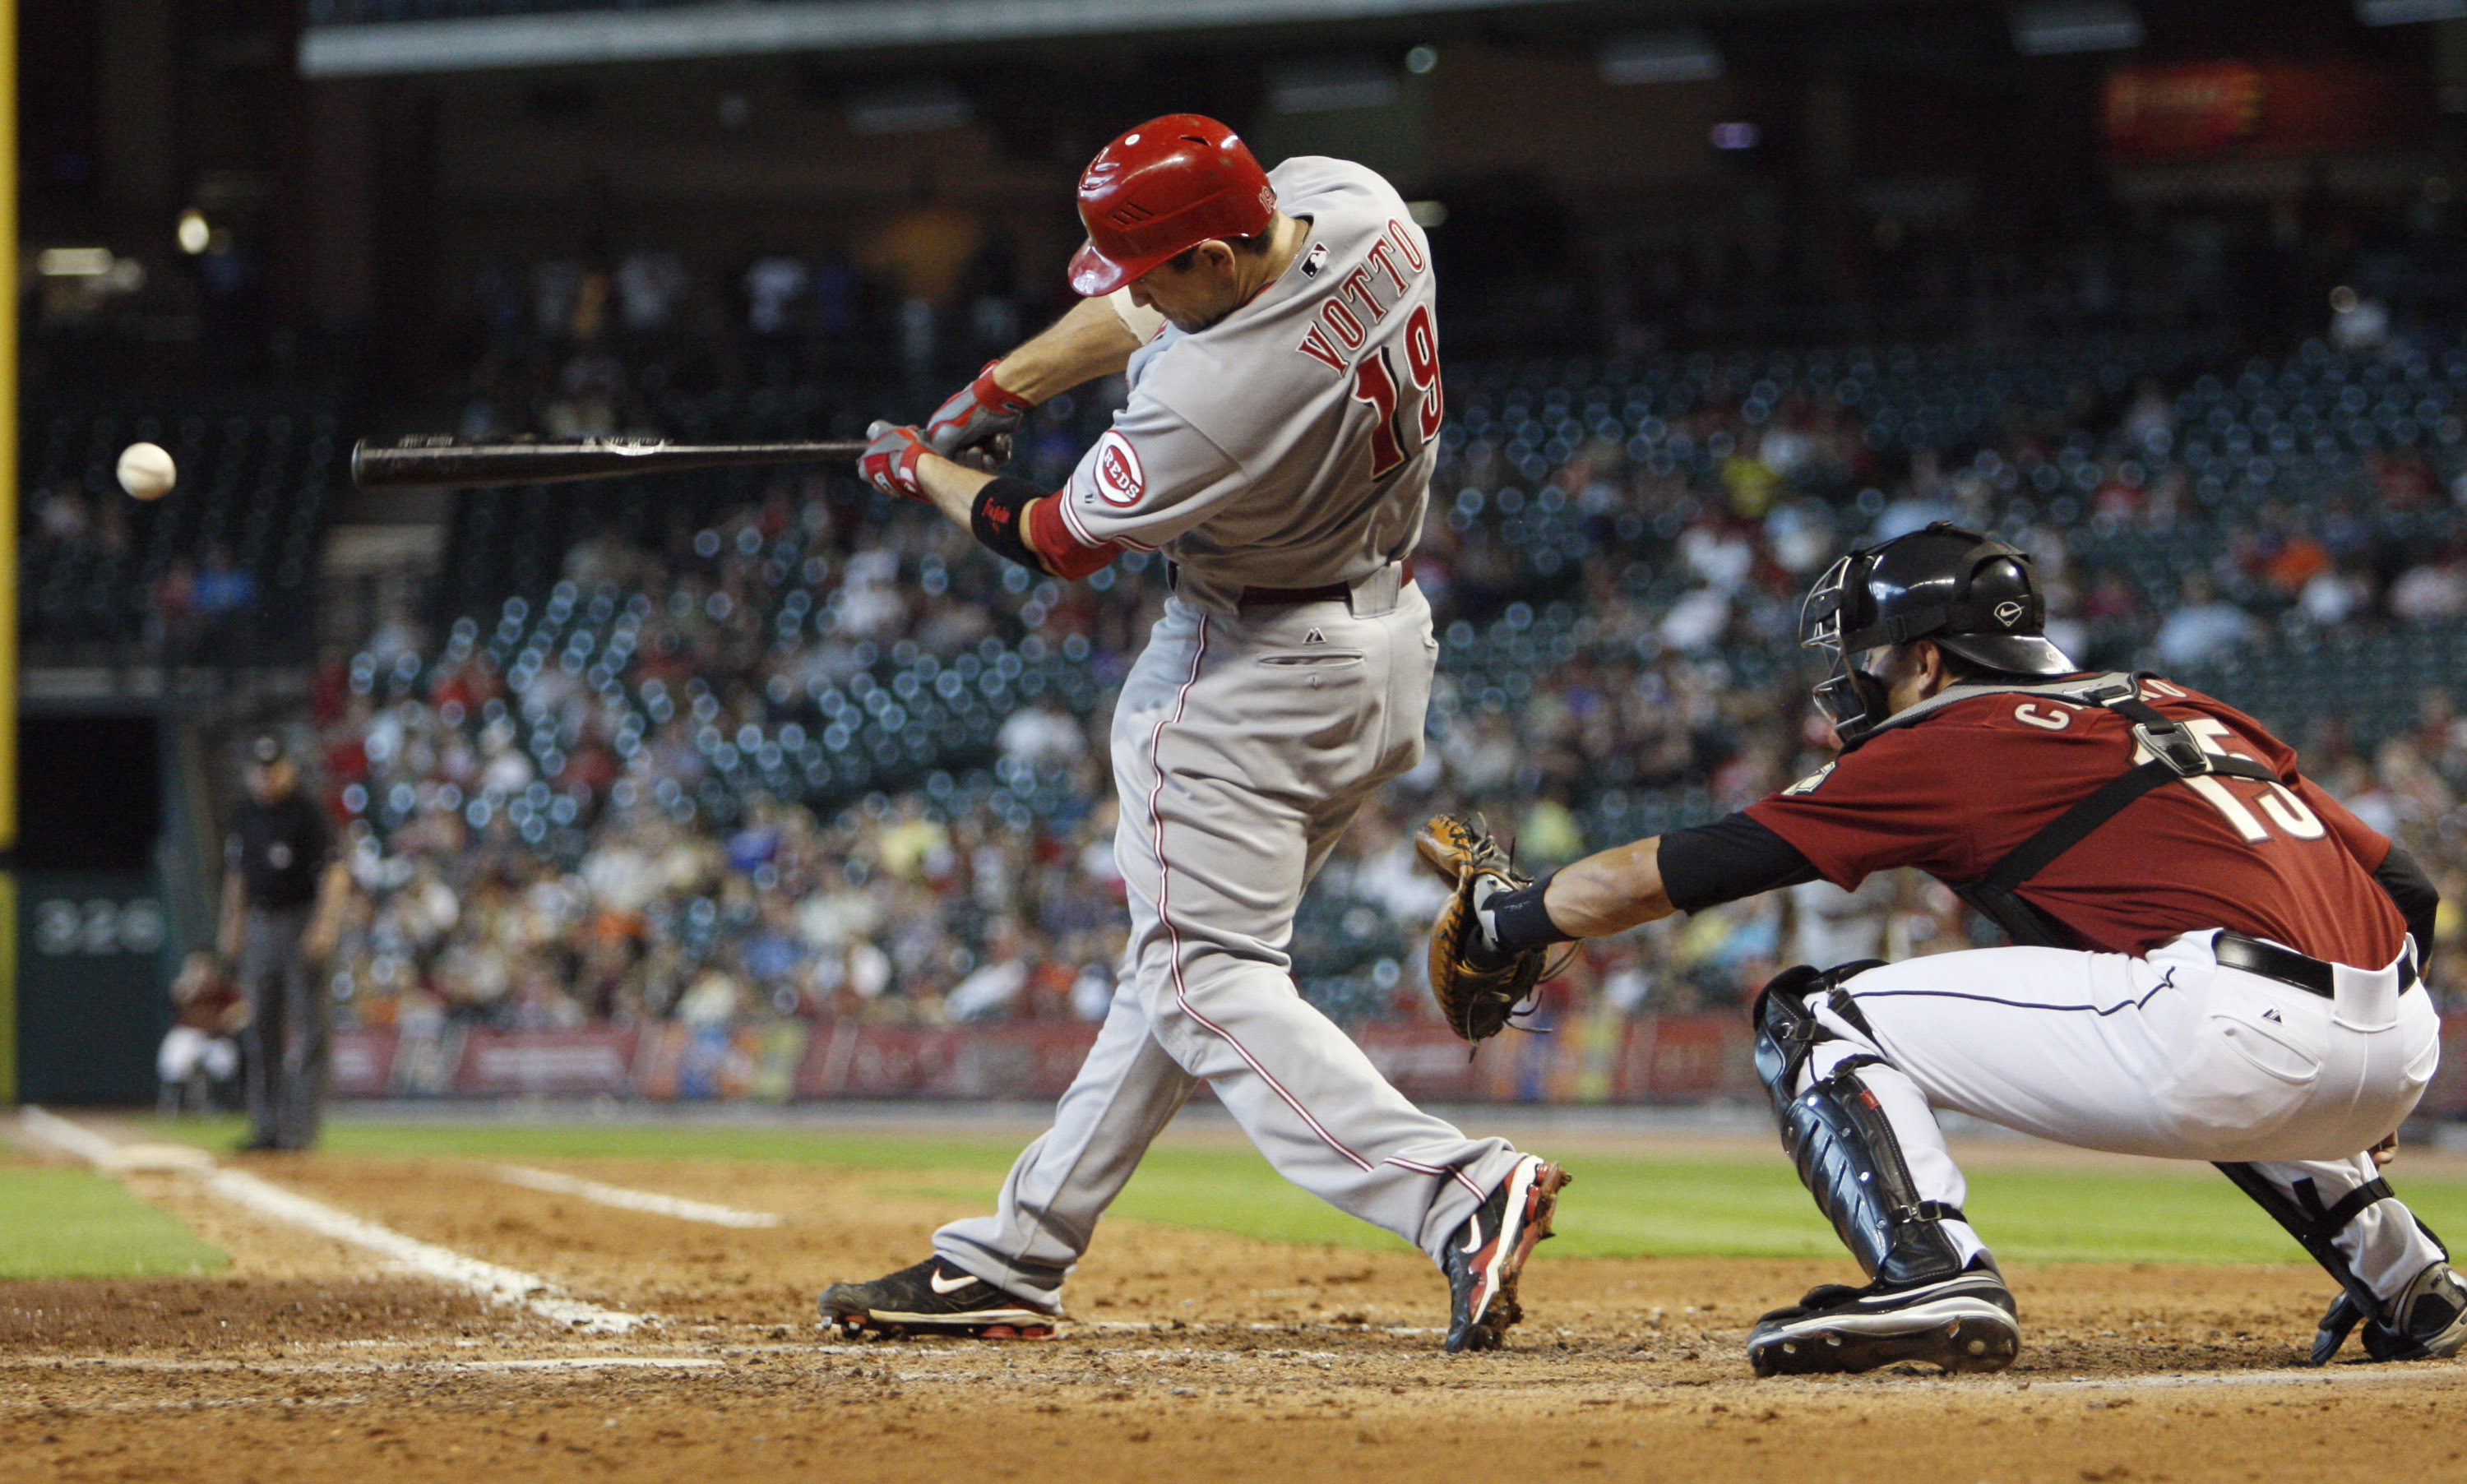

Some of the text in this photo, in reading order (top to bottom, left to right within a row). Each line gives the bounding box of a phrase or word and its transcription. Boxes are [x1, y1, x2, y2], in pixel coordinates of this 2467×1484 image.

[1296, 216, 1425, 378] VOTTO
[1351, 302, 1443, 482] 19
[1104, 448, 1141, 499] REDS
[2125, 715, 2330, 846] 15
